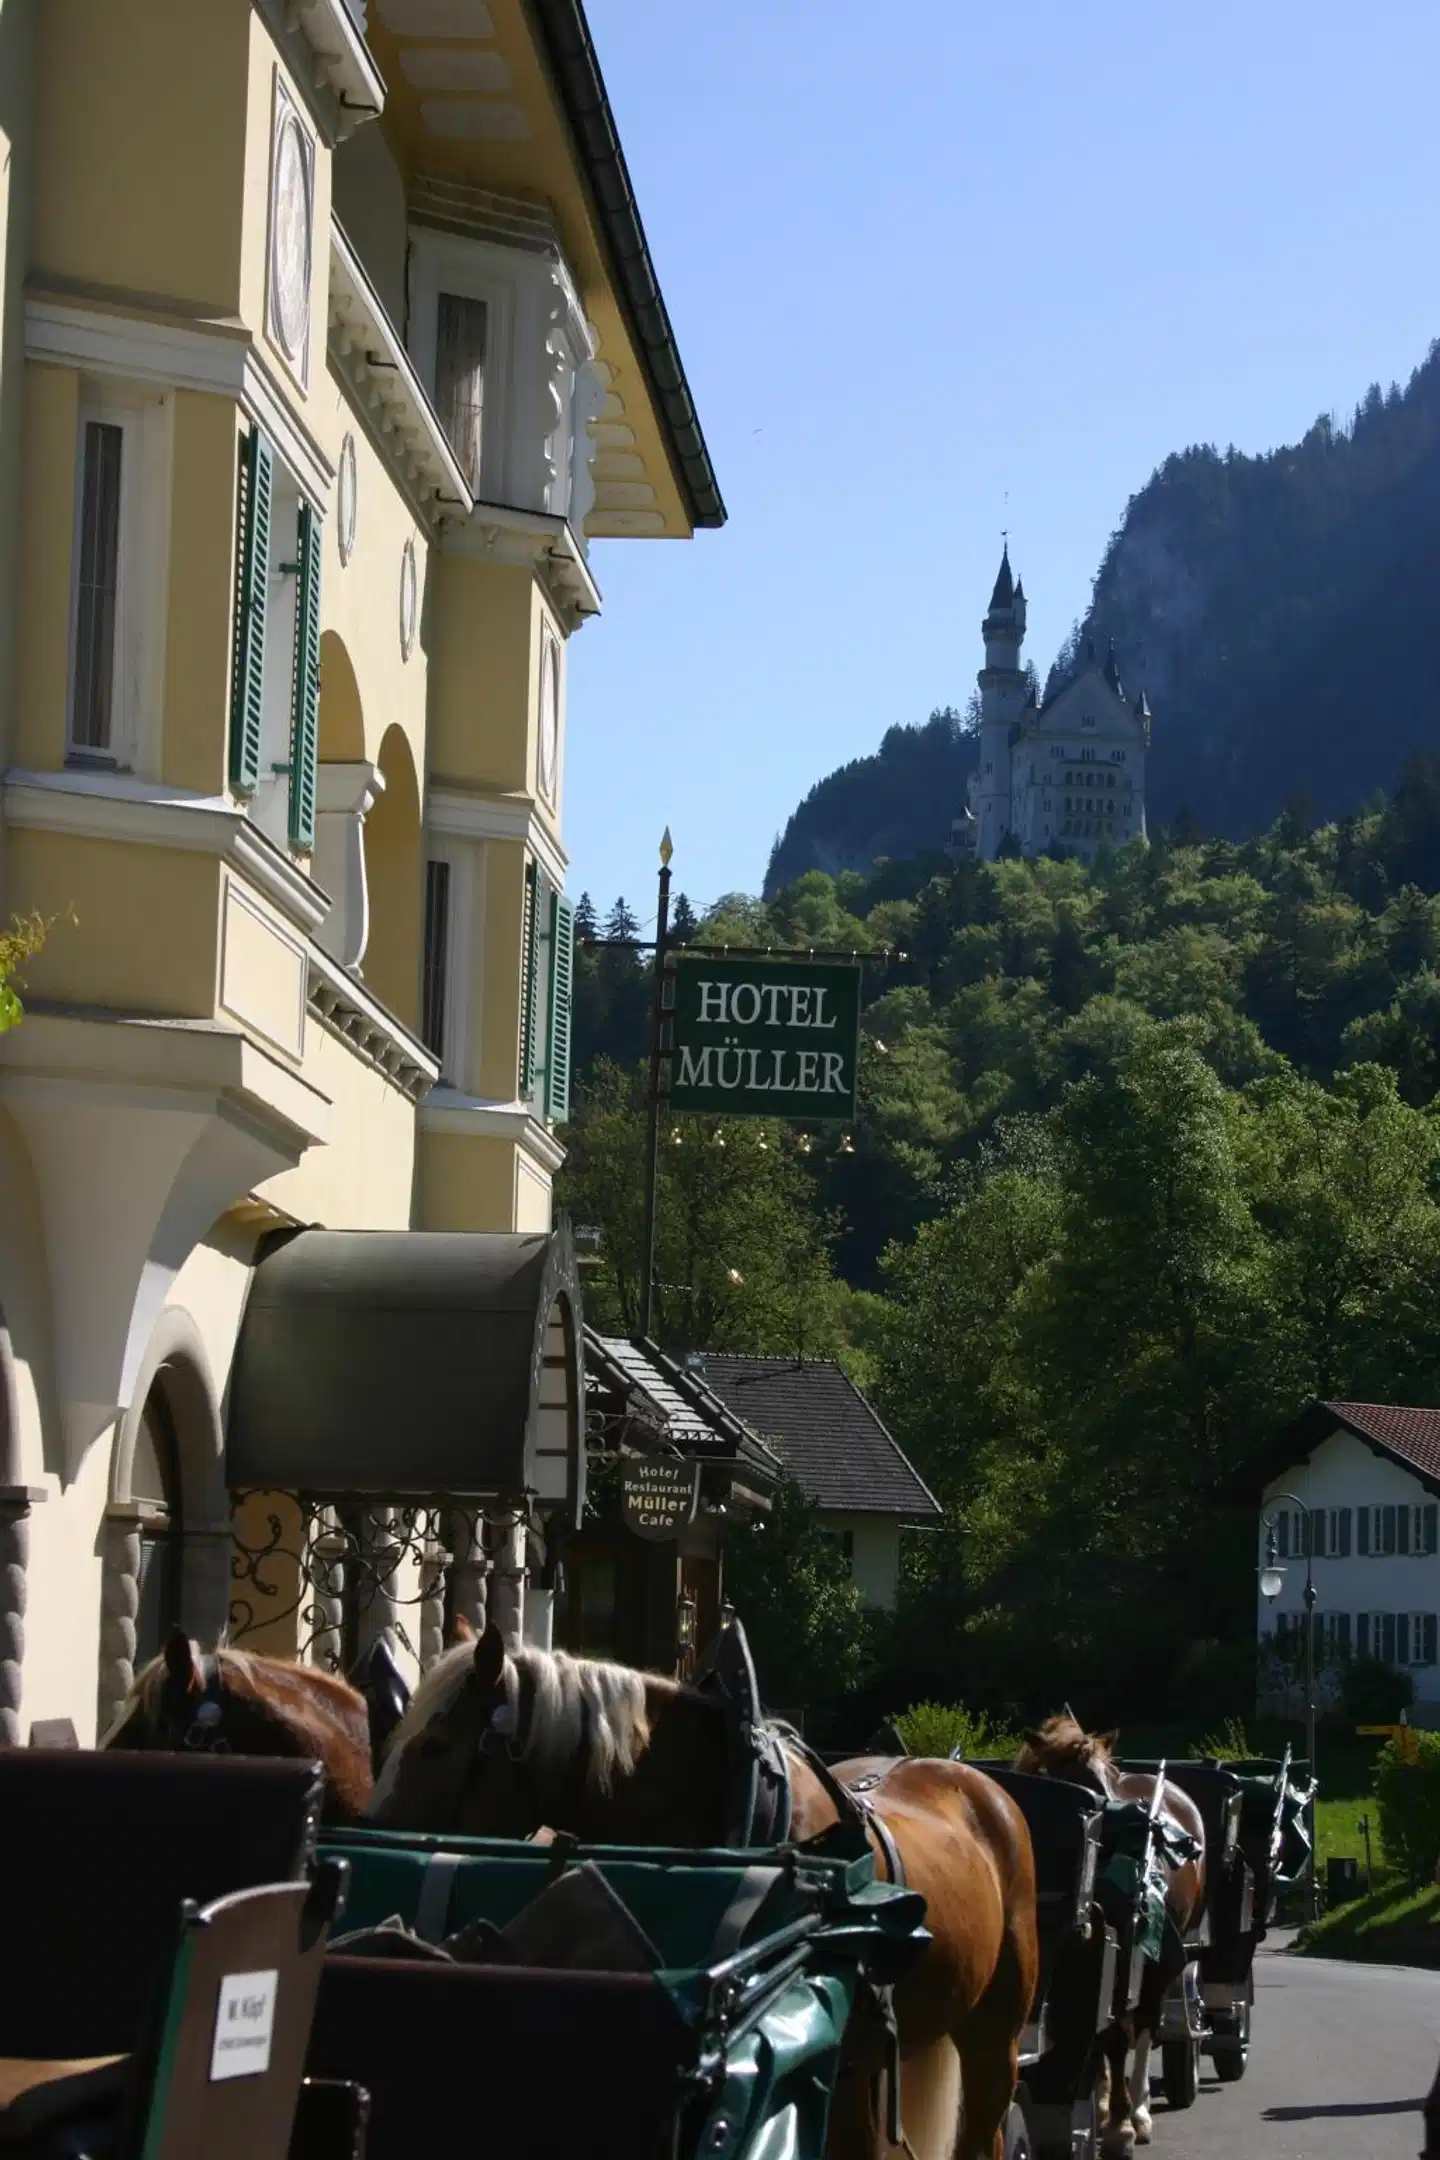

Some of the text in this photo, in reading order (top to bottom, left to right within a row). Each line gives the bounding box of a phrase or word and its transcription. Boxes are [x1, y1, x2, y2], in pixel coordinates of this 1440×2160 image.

[695, 981, 837, 1028] HOTEL
[675, 1037, 850, 1094] MÜLLER
[639, 1465, 679, 1480] Hotel
[624, 1480, 692, 1495] Restaurant
[628, 1494, 687, 1512] Müller
